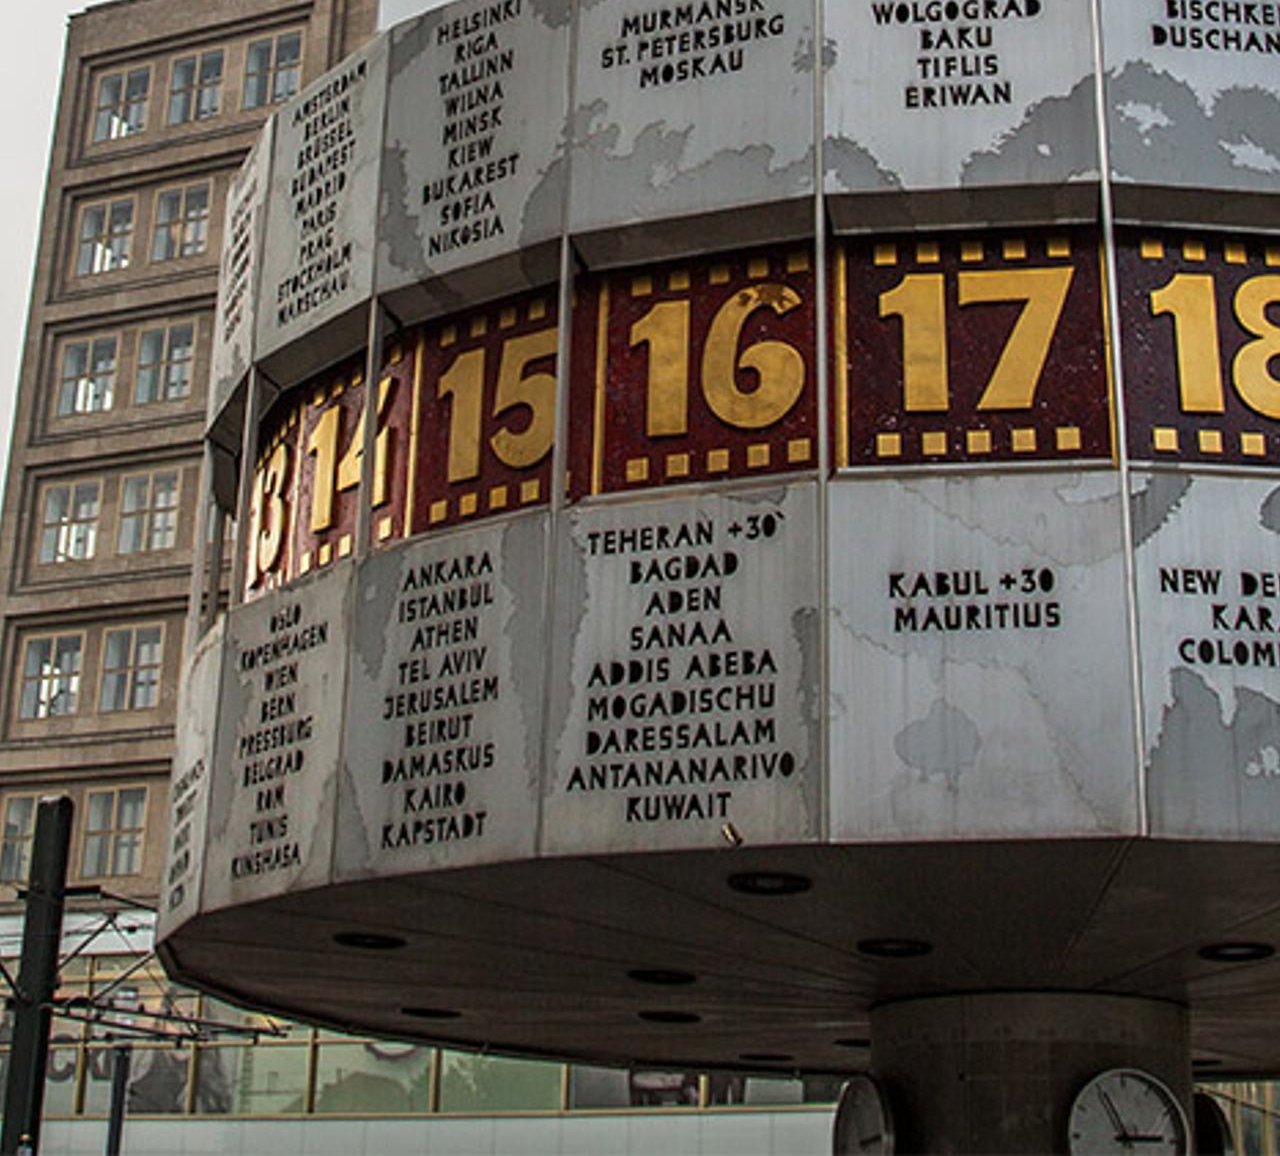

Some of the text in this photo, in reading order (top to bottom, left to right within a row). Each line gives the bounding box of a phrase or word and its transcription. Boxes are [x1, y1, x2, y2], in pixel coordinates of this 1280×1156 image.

[454, 32, 498, 64] RIGA
[601, 14, 785, 69] ST. PETERSBURG
[921, 26, 992, 50] BAKU
[438, 48, 513, 95] TALLINN
[640, 48, 743, 88] MOSKAU
[917, 54, 999, 79] TIFLIS
[444, 80, 504, 118] WILNA
[905, 81, 1011, 109] ERIWAN
[304, 95, 350, 142] BERLIN
[443, 106, 502, 145] MINSK
[292, 138, 356, 196] BUDAPEST
[448, 134, 494, 170] KIEW
[423, 153, 519, 205] BUKAREST
[440, 191, 495, 226] SOFIA
[428, 215, 504, 258] NIKOSIA
[877, 266, 1075, 412] 17
[629, 283, 805, 437] 16
[438, 329, 557, 483] 15
[307, 374, 392, 532] 14
[589, 521, 712, 555] TEHERAN
[403, 551, 492, 592] ANKARA
[631, 552, 738, 584] BAGDAD
[889, 569, 1054, 597] KABUL +30
[1160, 568, 1221, 594] NEW
[399, 583, 493, 622] ISTANBUL
[646, 586, 721, 616] ADEN
[895, 602, 1060, 632] MAURITIUS
[410, 616, 478, 652] ATHEN
[631, 619, 732, 650] SANAA
[399, 647, 487, 684] TEL AVIV
[588, 650, 777, 687] ADDIS ABEBA
[261, 692, 295, 723] BERN
[383, 676, 498, 720] JERUSALEM
[588, 684, 774, 721] MOGADISCHU
[406, 714, 473, 747] BEIRUT
[587, 718, 775, 755] DARESSALAM
[243, 748, 304, 787] BELGRAD
[382, 743, 494, 784] DAMASKUS
[567, 751, 794, 791] ANTANANARIVO
[404, 781, 466, 813] KAIRO
[627, 792, 731, 822] KUWAIT
[381, 812, 487, 849] KAPSTADT
